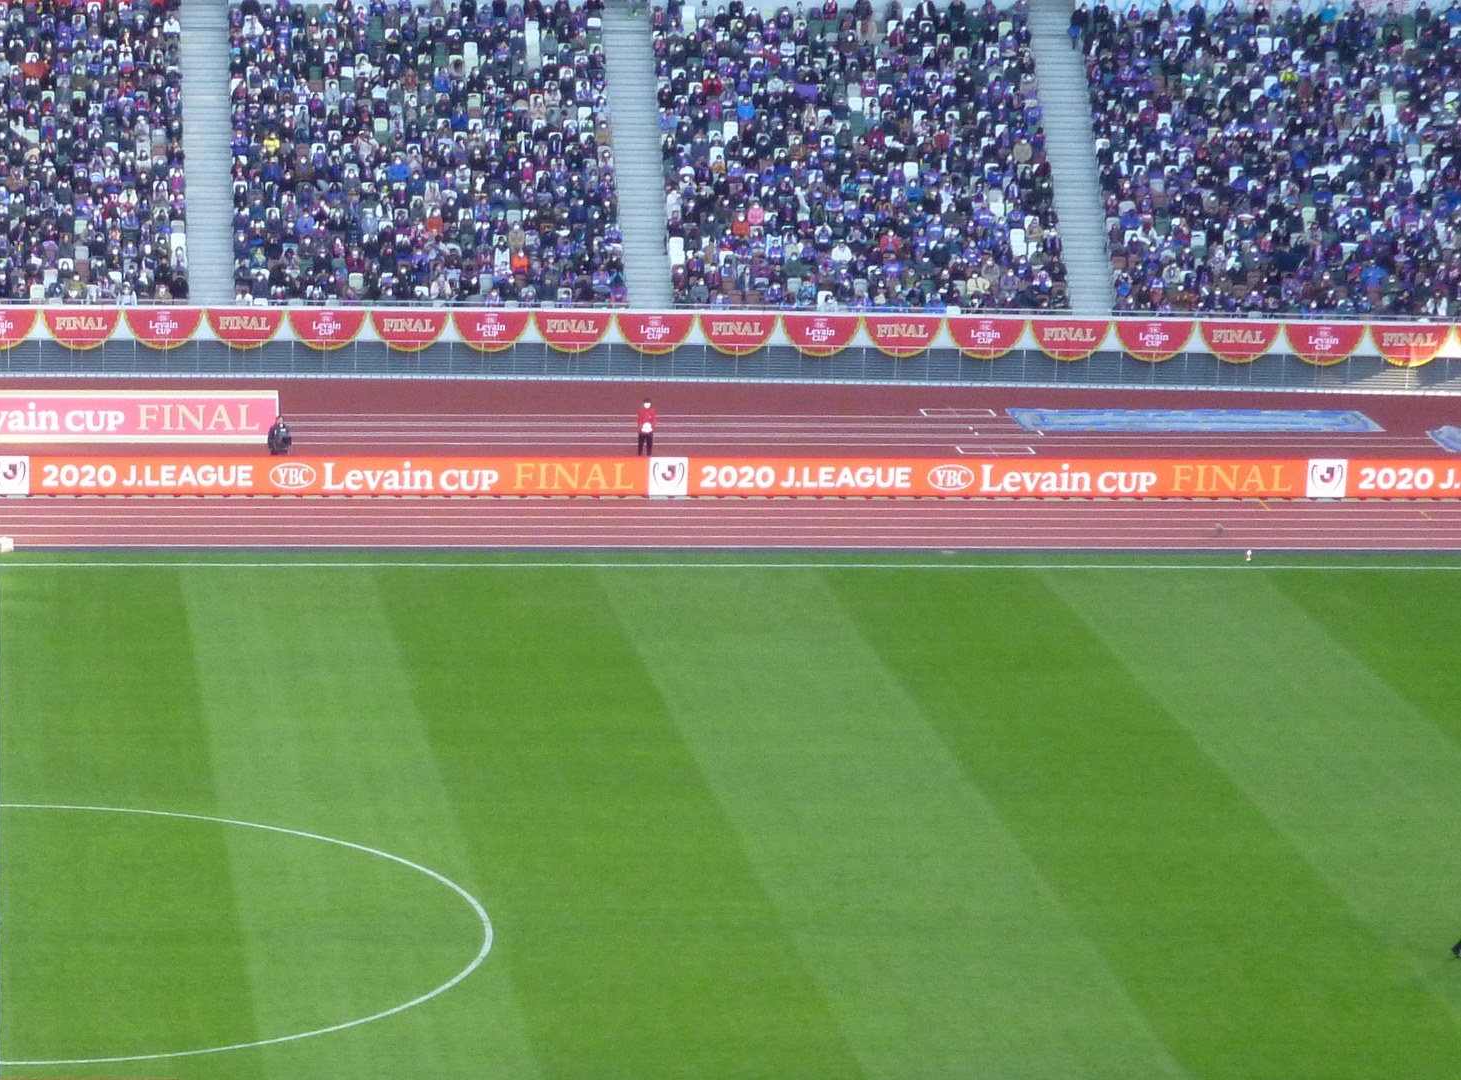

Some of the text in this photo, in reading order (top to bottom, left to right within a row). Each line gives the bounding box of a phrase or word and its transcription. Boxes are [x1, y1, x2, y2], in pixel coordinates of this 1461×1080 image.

[56, 316, 107, 330] FINAL
[149, 319, 178, 330] Levain
[219, 316, 270, 330] FINAL
[312, 319, 341, 330] Levain
[383, 318, 435, 332] FINAL
[476, 321, 506, 332] Levain
[546, 319, 598, 334] FINAL
[640, 324, 670, 336] Levain
[712, 321, 764, 336] FINAL
[806, 326, 835, 337] Levain
[877, 324, 928, 338] FINAL
[971, 329, 1000, 340] Levain
[1044, 328, 1096, 342] FINAL
[1139, 332, 1169, 342] Levain
[1212, 330, 1265, 344] FINAL
[1309, 334, 1338, 346] Levain
[1383, 332, 1436, 347] FINAL
[65, 410, 125, 432] CUP
[137, 403, 260, 431] FINAL
[42, 464, 116, 486] 2020
[122, 464, 253, 486] J.LEAGUE
[277, 467, 309, 486] YBC
[322, 461, 434, 491] Levain
[440, 469, 499, 491] CUP
[513, 462, 634, 490] FINAL
[700, 466, 775, 488] 2020
[780, 466, 911, 488] J.LEAGUE
[935, 469, 967, 487] YBC
[979, 463, 1092, 492] Levain
[1097, 470, 1157, 493] CUP
[1170, 464, 1292, 492] FINAL
[1358, 467, 1434, 490] 2020
